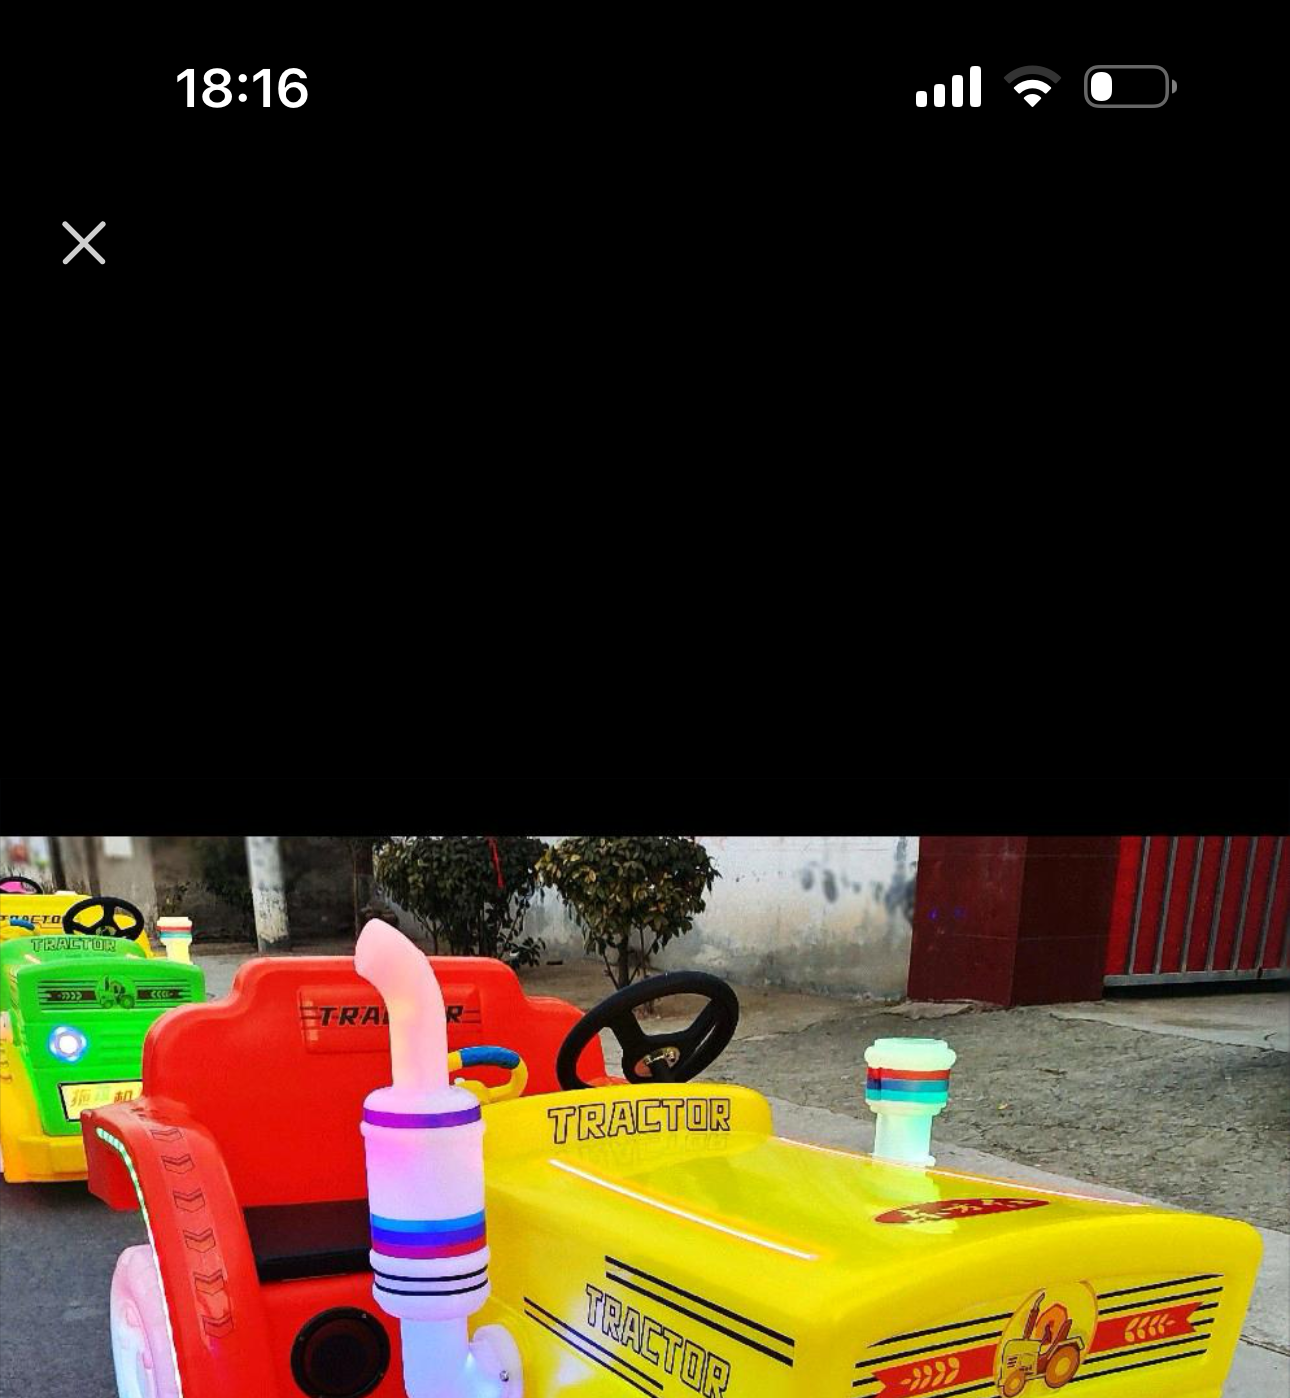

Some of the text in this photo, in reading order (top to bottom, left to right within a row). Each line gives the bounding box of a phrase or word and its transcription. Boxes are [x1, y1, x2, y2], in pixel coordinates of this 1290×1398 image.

[31, 937, 117, 952] TRACTOR
[319, 1004, 464, 1027] TRAR
[547, 1097, 731, 1145] TRACTOR
